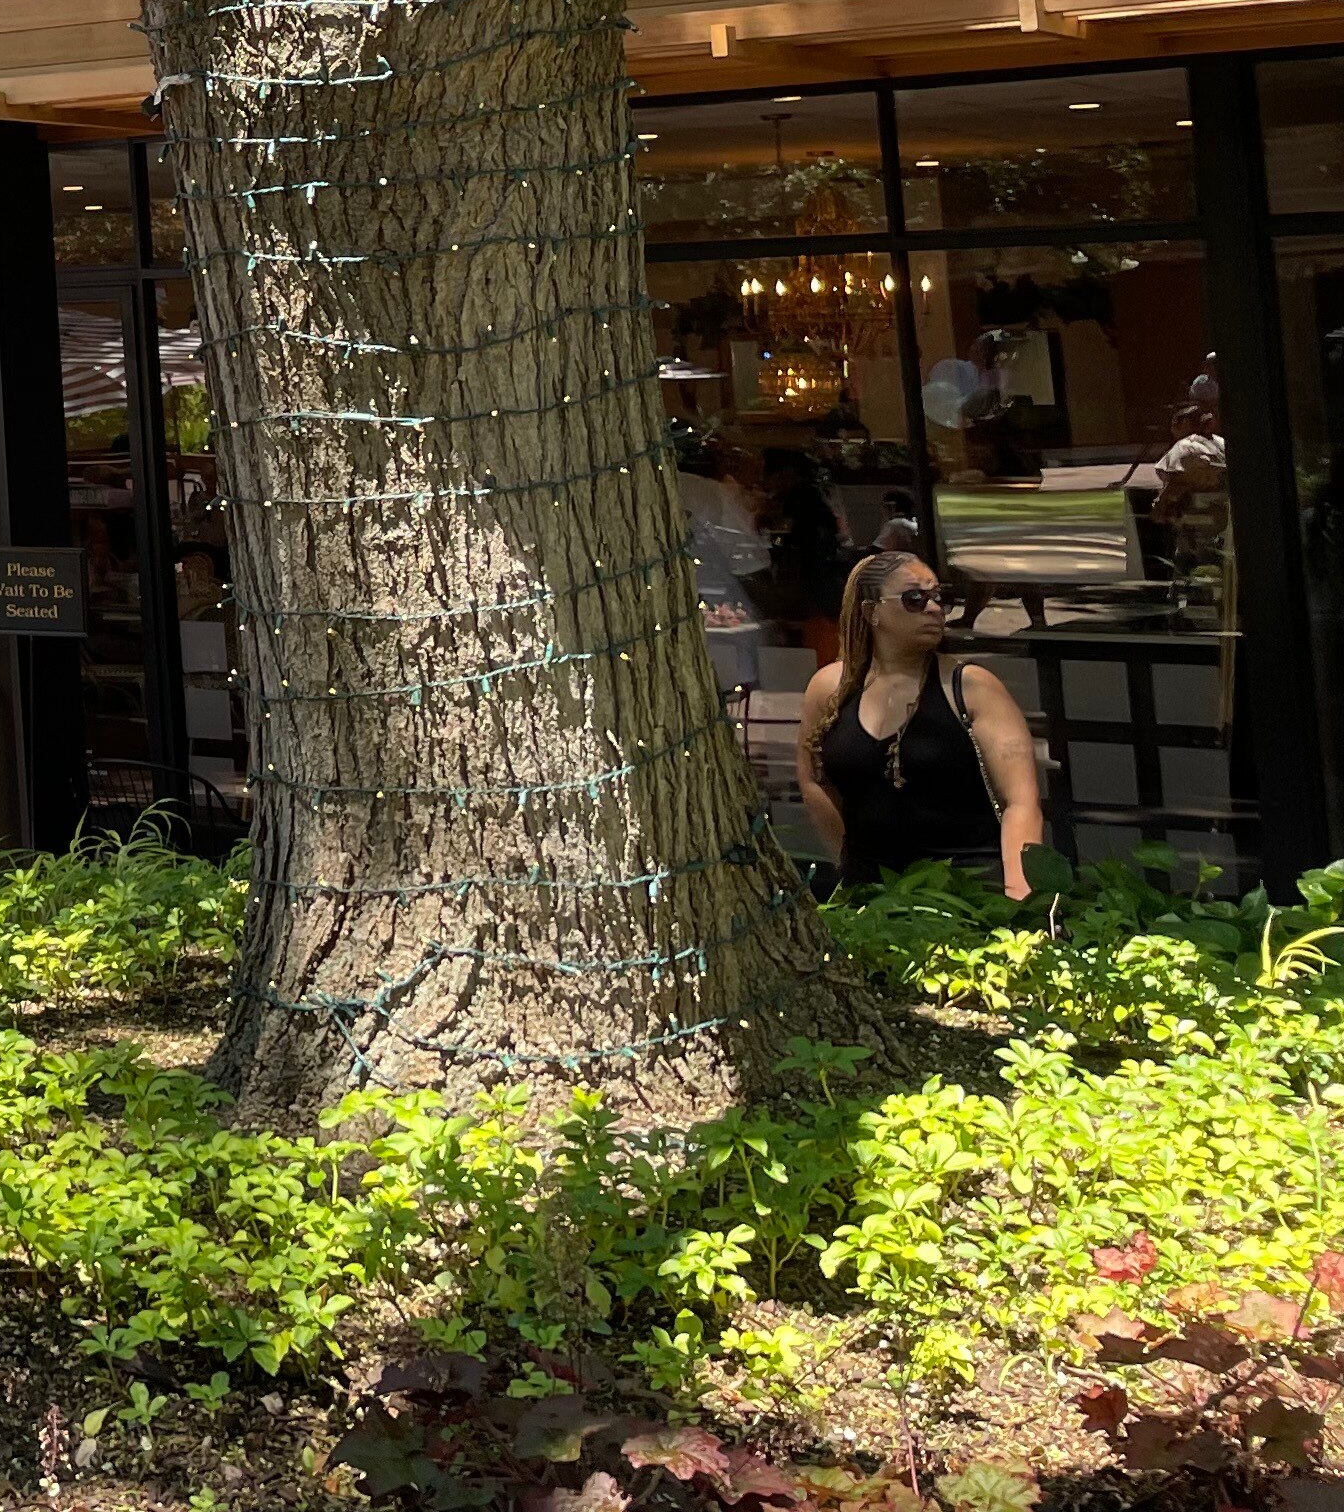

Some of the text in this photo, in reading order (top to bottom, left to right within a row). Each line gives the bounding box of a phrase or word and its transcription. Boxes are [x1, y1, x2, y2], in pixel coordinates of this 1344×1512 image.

[7, 562, 56, 577] Please
[28, 583, 49, 598] To
[53, 584, 74, 599] Be
[6, 603, 59, 619] Seated
